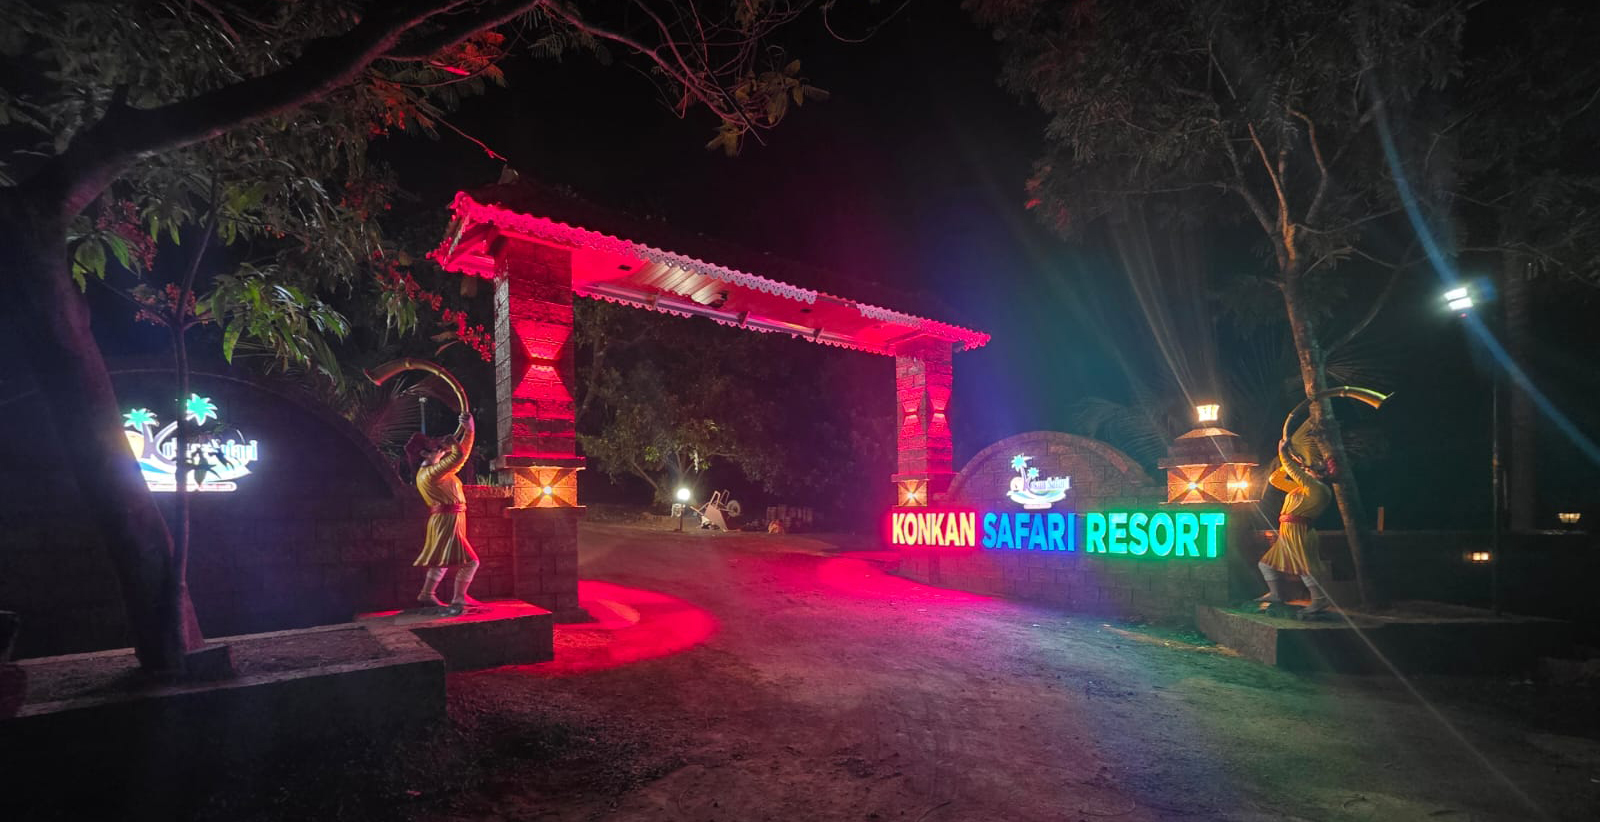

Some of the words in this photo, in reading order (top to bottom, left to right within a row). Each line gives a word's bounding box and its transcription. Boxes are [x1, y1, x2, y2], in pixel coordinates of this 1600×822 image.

[892, 512, 975, 547] KONKAN
[982, 511, 1076, 551] SAFARI
[1086, 512, 1225, 558] RESORT
